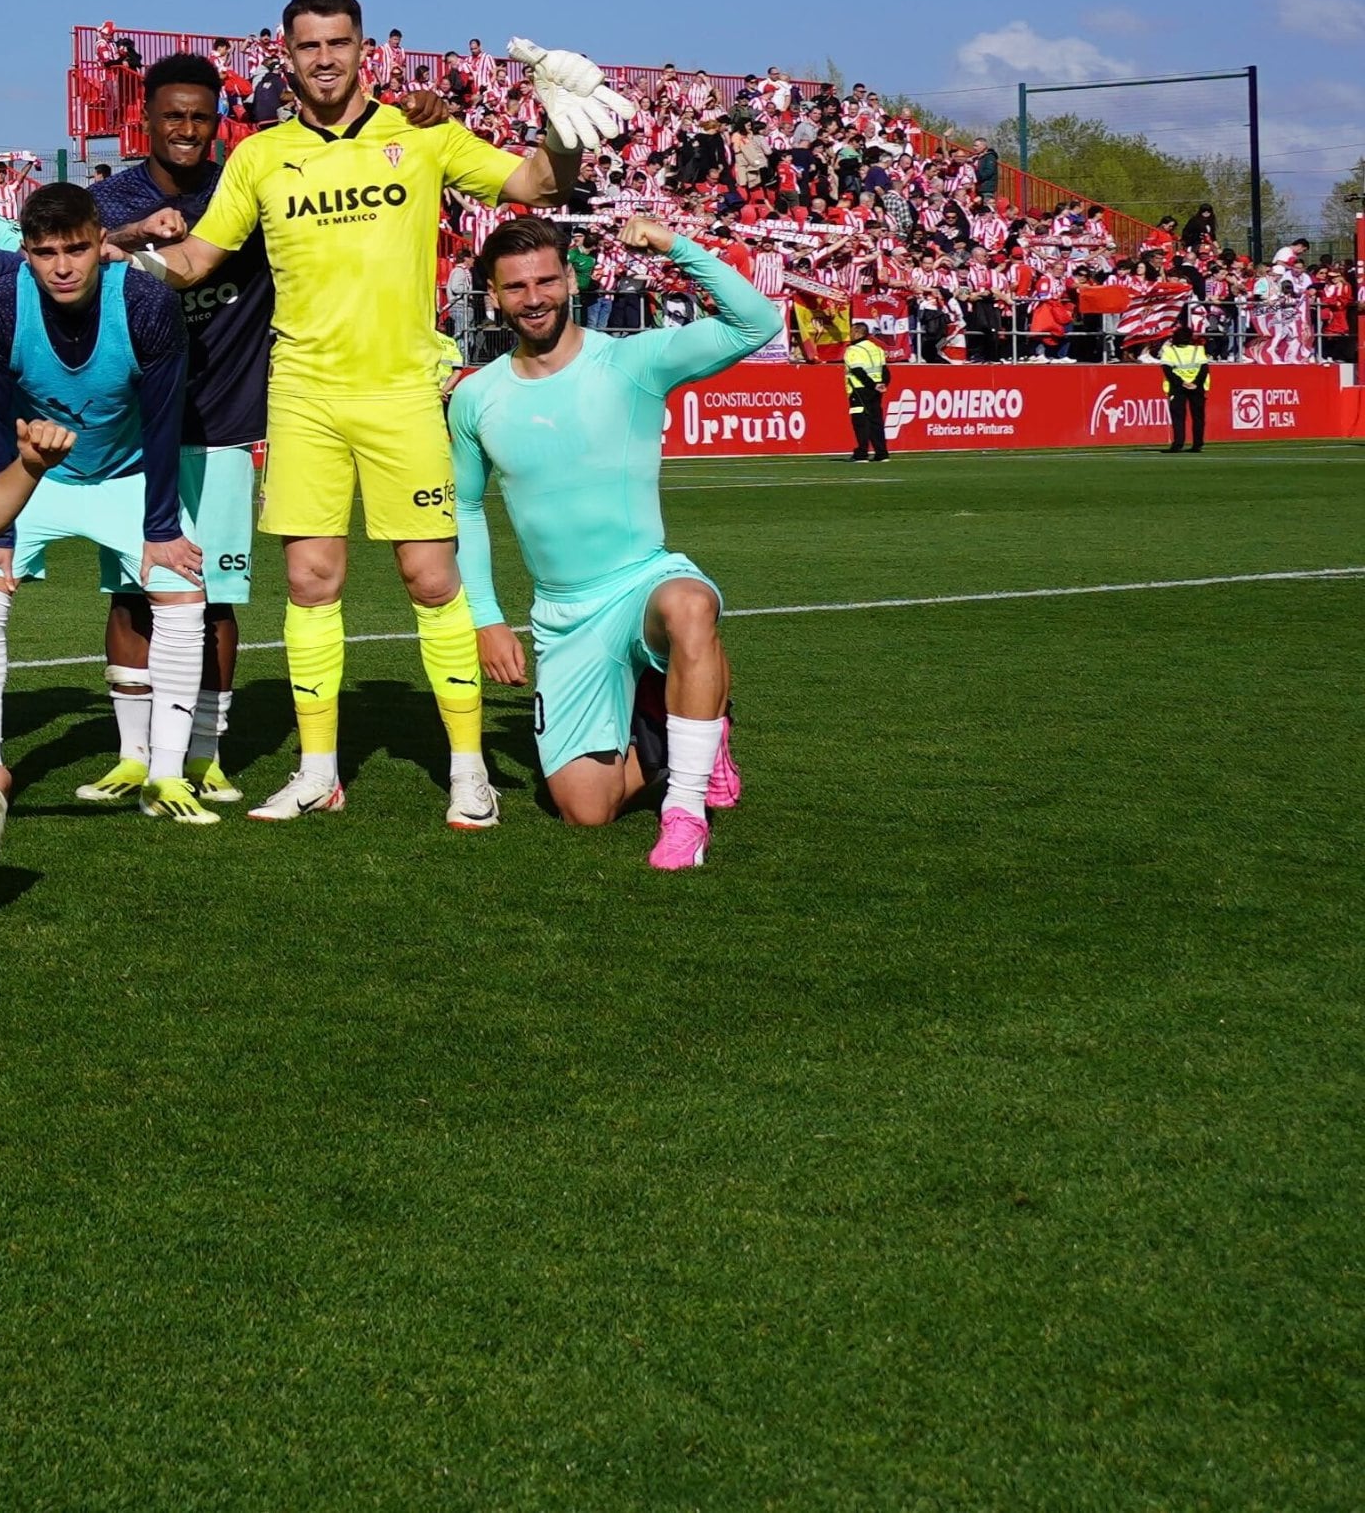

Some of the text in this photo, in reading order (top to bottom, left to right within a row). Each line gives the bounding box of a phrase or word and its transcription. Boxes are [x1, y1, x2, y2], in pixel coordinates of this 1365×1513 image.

[285, 183, 408, 220] JALISCO
[316, 211, 377, 227] ES MÉXICO
[704, 391, 803, 408] CONSTRUCCIONES
[918, 388, 1024, 419] DOHERCO
[1265, 389, 1300, 405] OPTICA
[683, 390, 807, 446] Orruño
[1269, 411, 1296, 428] PILSA
[926, 420, 1015, 437] Fábrica de Pinturas
